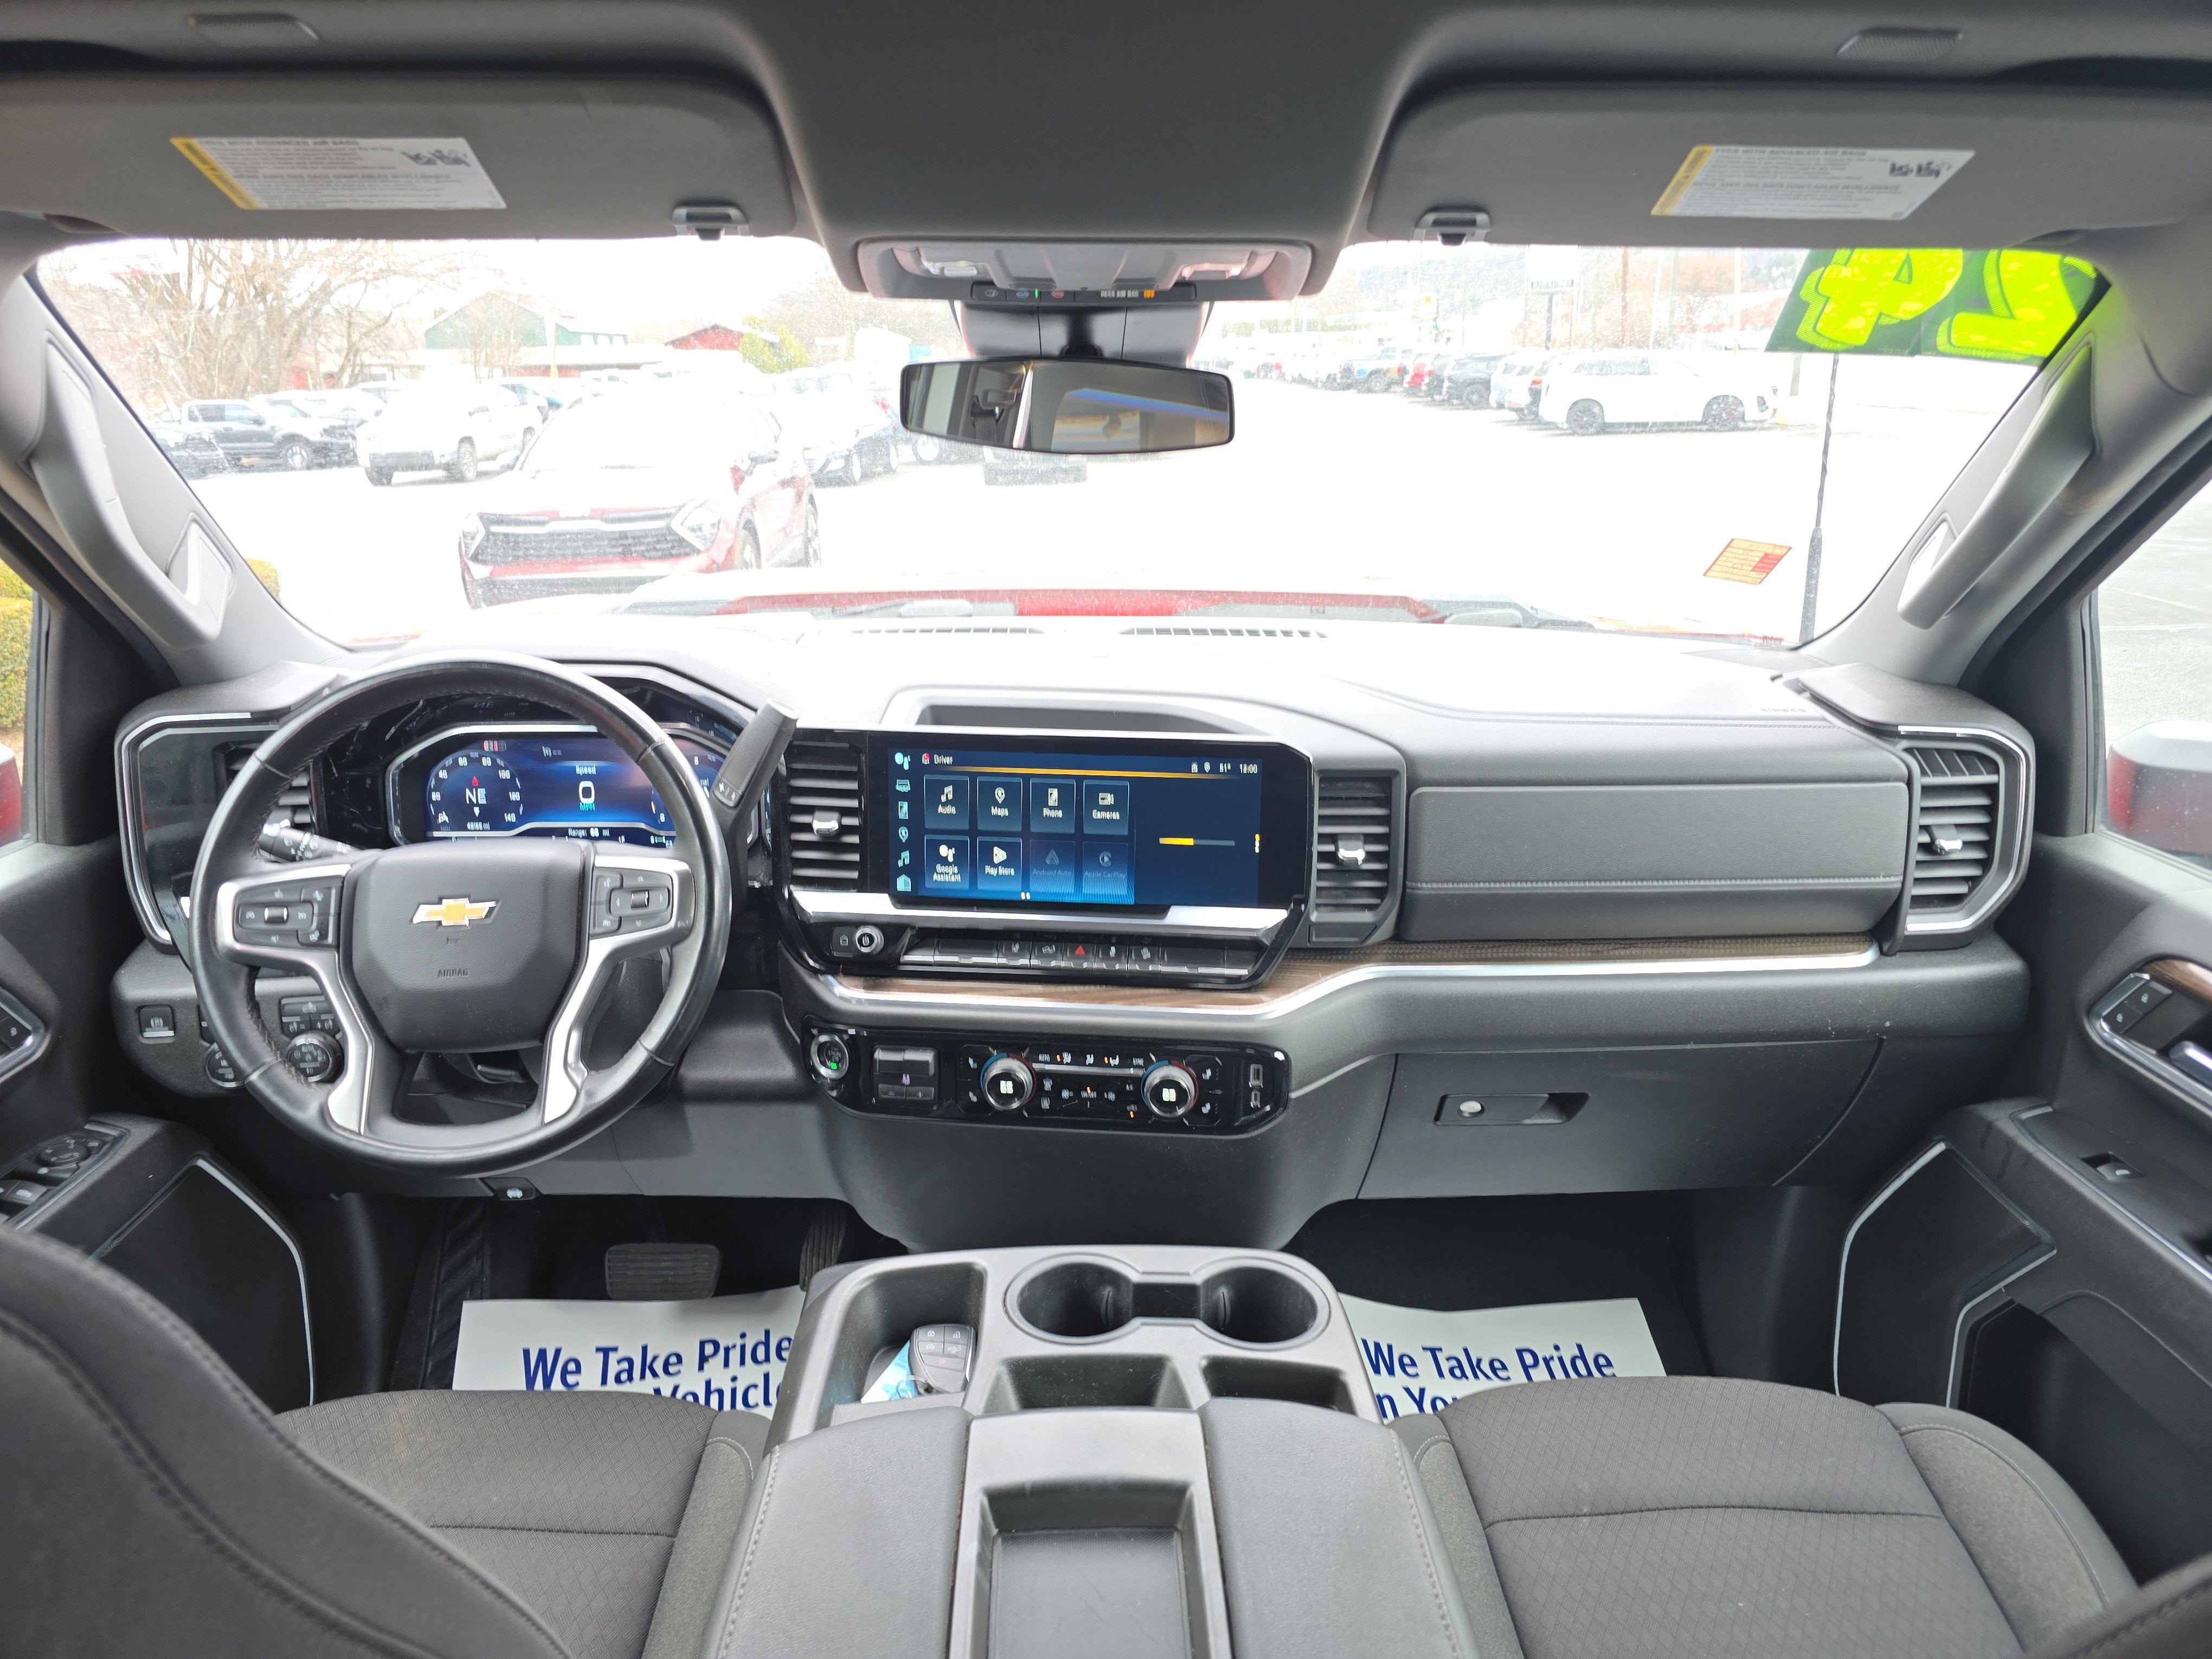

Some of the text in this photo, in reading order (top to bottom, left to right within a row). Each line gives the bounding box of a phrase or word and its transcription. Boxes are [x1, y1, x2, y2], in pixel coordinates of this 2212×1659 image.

[934, 754, 953, 764] Driver
[576, 764, 596, 776] Speed
[466, 788, 487, 804] NE
[579, 781, 595, 804] 0
[938, 804, 956, 814] Audio
[991, 806, 1008, 816] Maps
[1043, 807, 1063, 818] Phone
[1092, 809, 1120, 820] Cameras
[936, 864, 958, 874] Google
[985, 865, 1014, 877] Play Store
[933, 872, 961, 882] Assistant
[1039, 1053, 1050, 1062] AUTO
[522, 1328, 794, 1391] We Take Pride
[1361, 1337, 1618, 1382] We Take Pride
[1402, 1385, 1459, 1414] Yo
